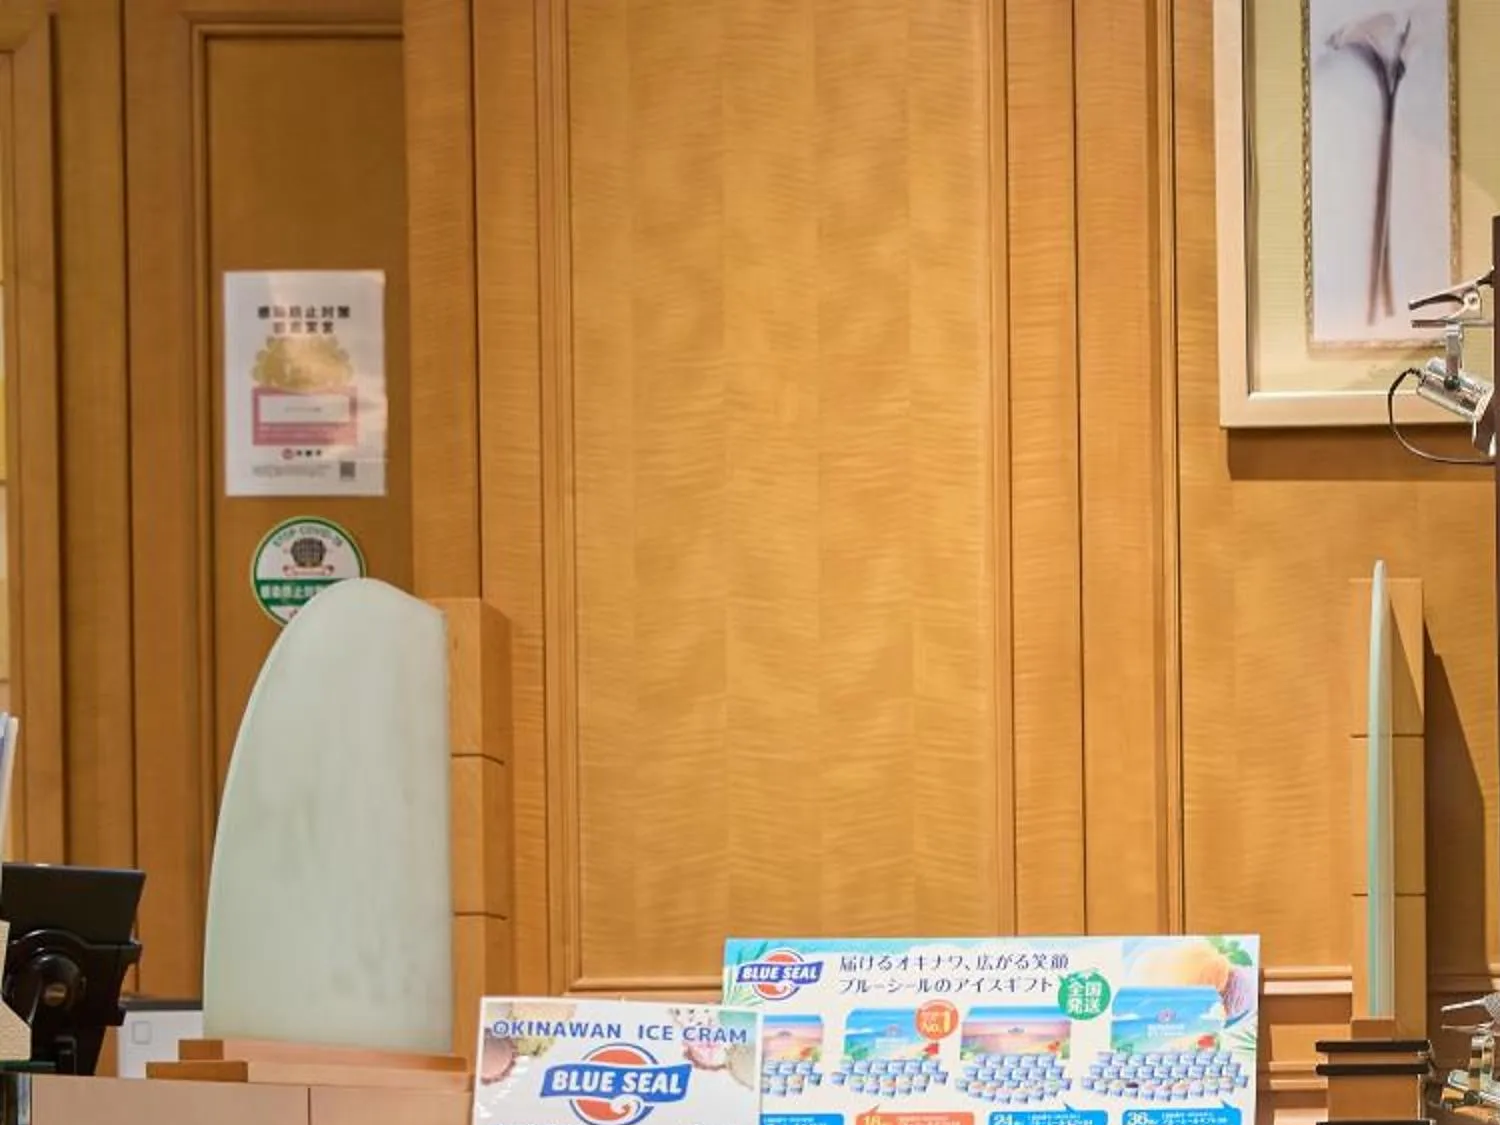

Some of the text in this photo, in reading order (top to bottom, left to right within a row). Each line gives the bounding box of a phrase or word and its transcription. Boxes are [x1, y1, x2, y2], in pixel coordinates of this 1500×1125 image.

[741, 963, 818, 981] BLUE SEAL
[839, 976, 1054, 994] ブルーシールのアイスギフト
[492, 1020, 748, 1044] OKINAWAN ICE CRAM
[552, 1070, 683, 1095] BLUE SEAL
